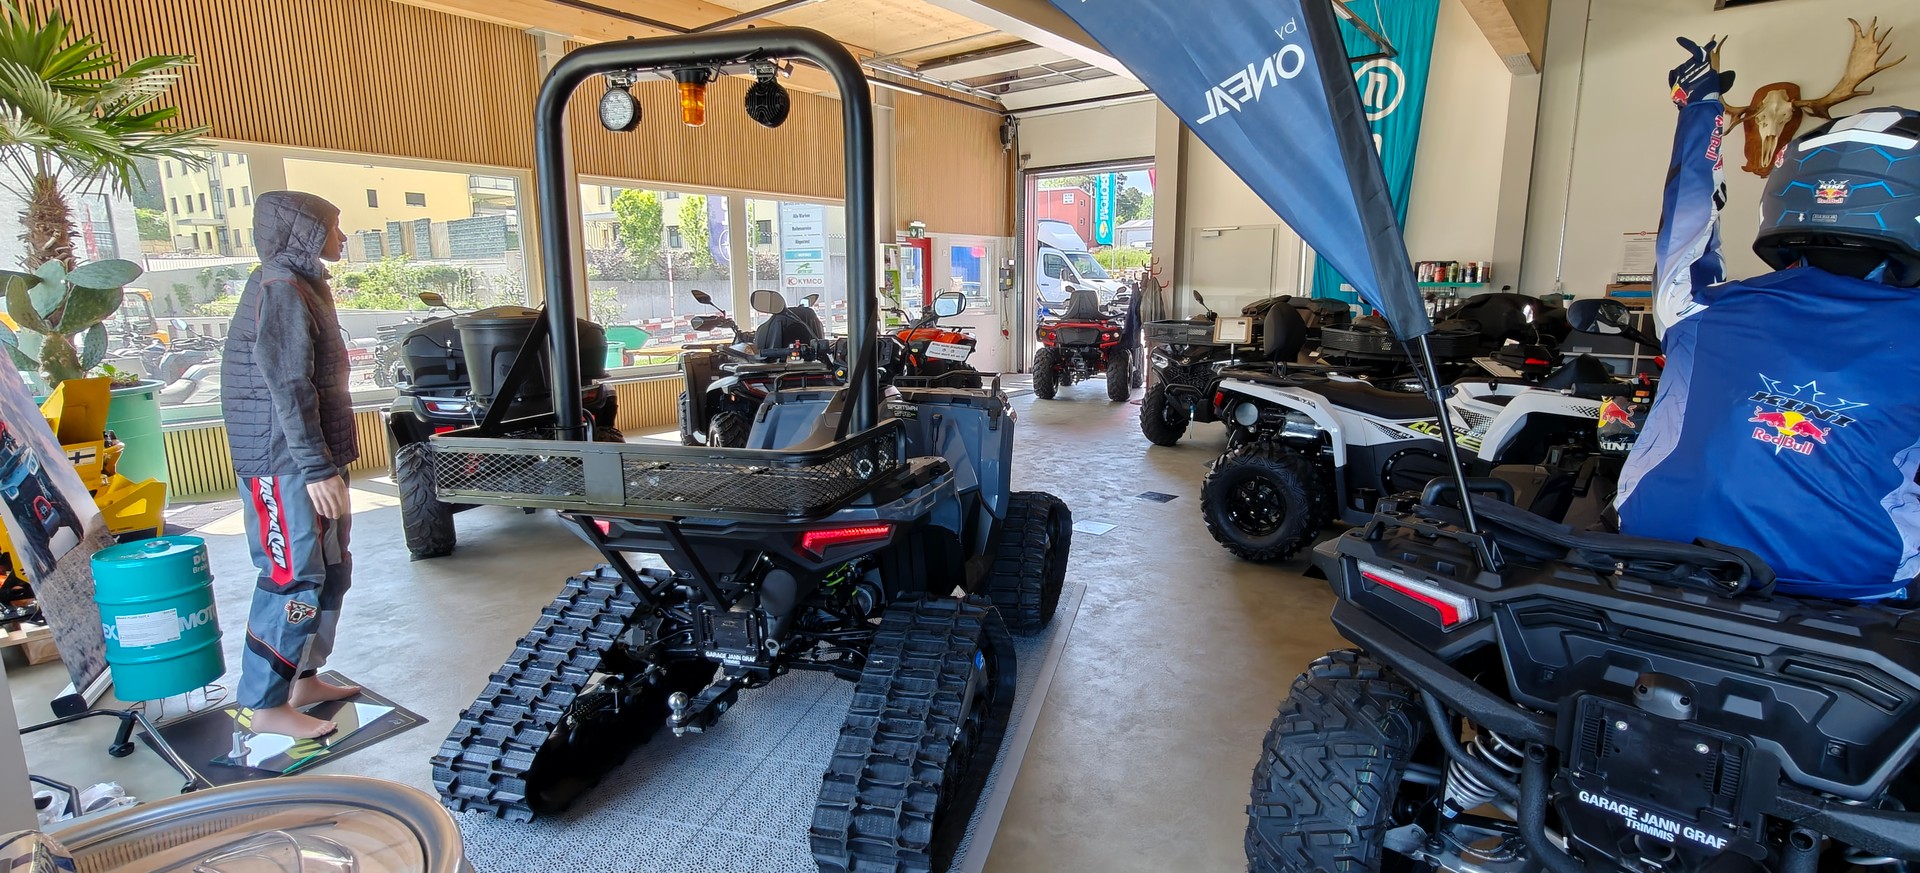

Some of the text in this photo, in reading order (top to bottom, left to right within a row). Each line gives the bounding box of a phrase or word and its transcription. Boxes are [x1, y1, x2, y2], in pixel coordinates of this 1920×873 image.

[1705, 135, 1722, 162] Bull
[1748, 391, 1856, 428] KINI
[1752, 427, 1815, 455] Red Bull
[193, 554, 207, 566] DO
[705, 651, 727, 659] GARAGE
[1578, 790, 1728, 849] GARAGE JANN GRAF
[1625, 817, 1675, 842] TRIMMIS
